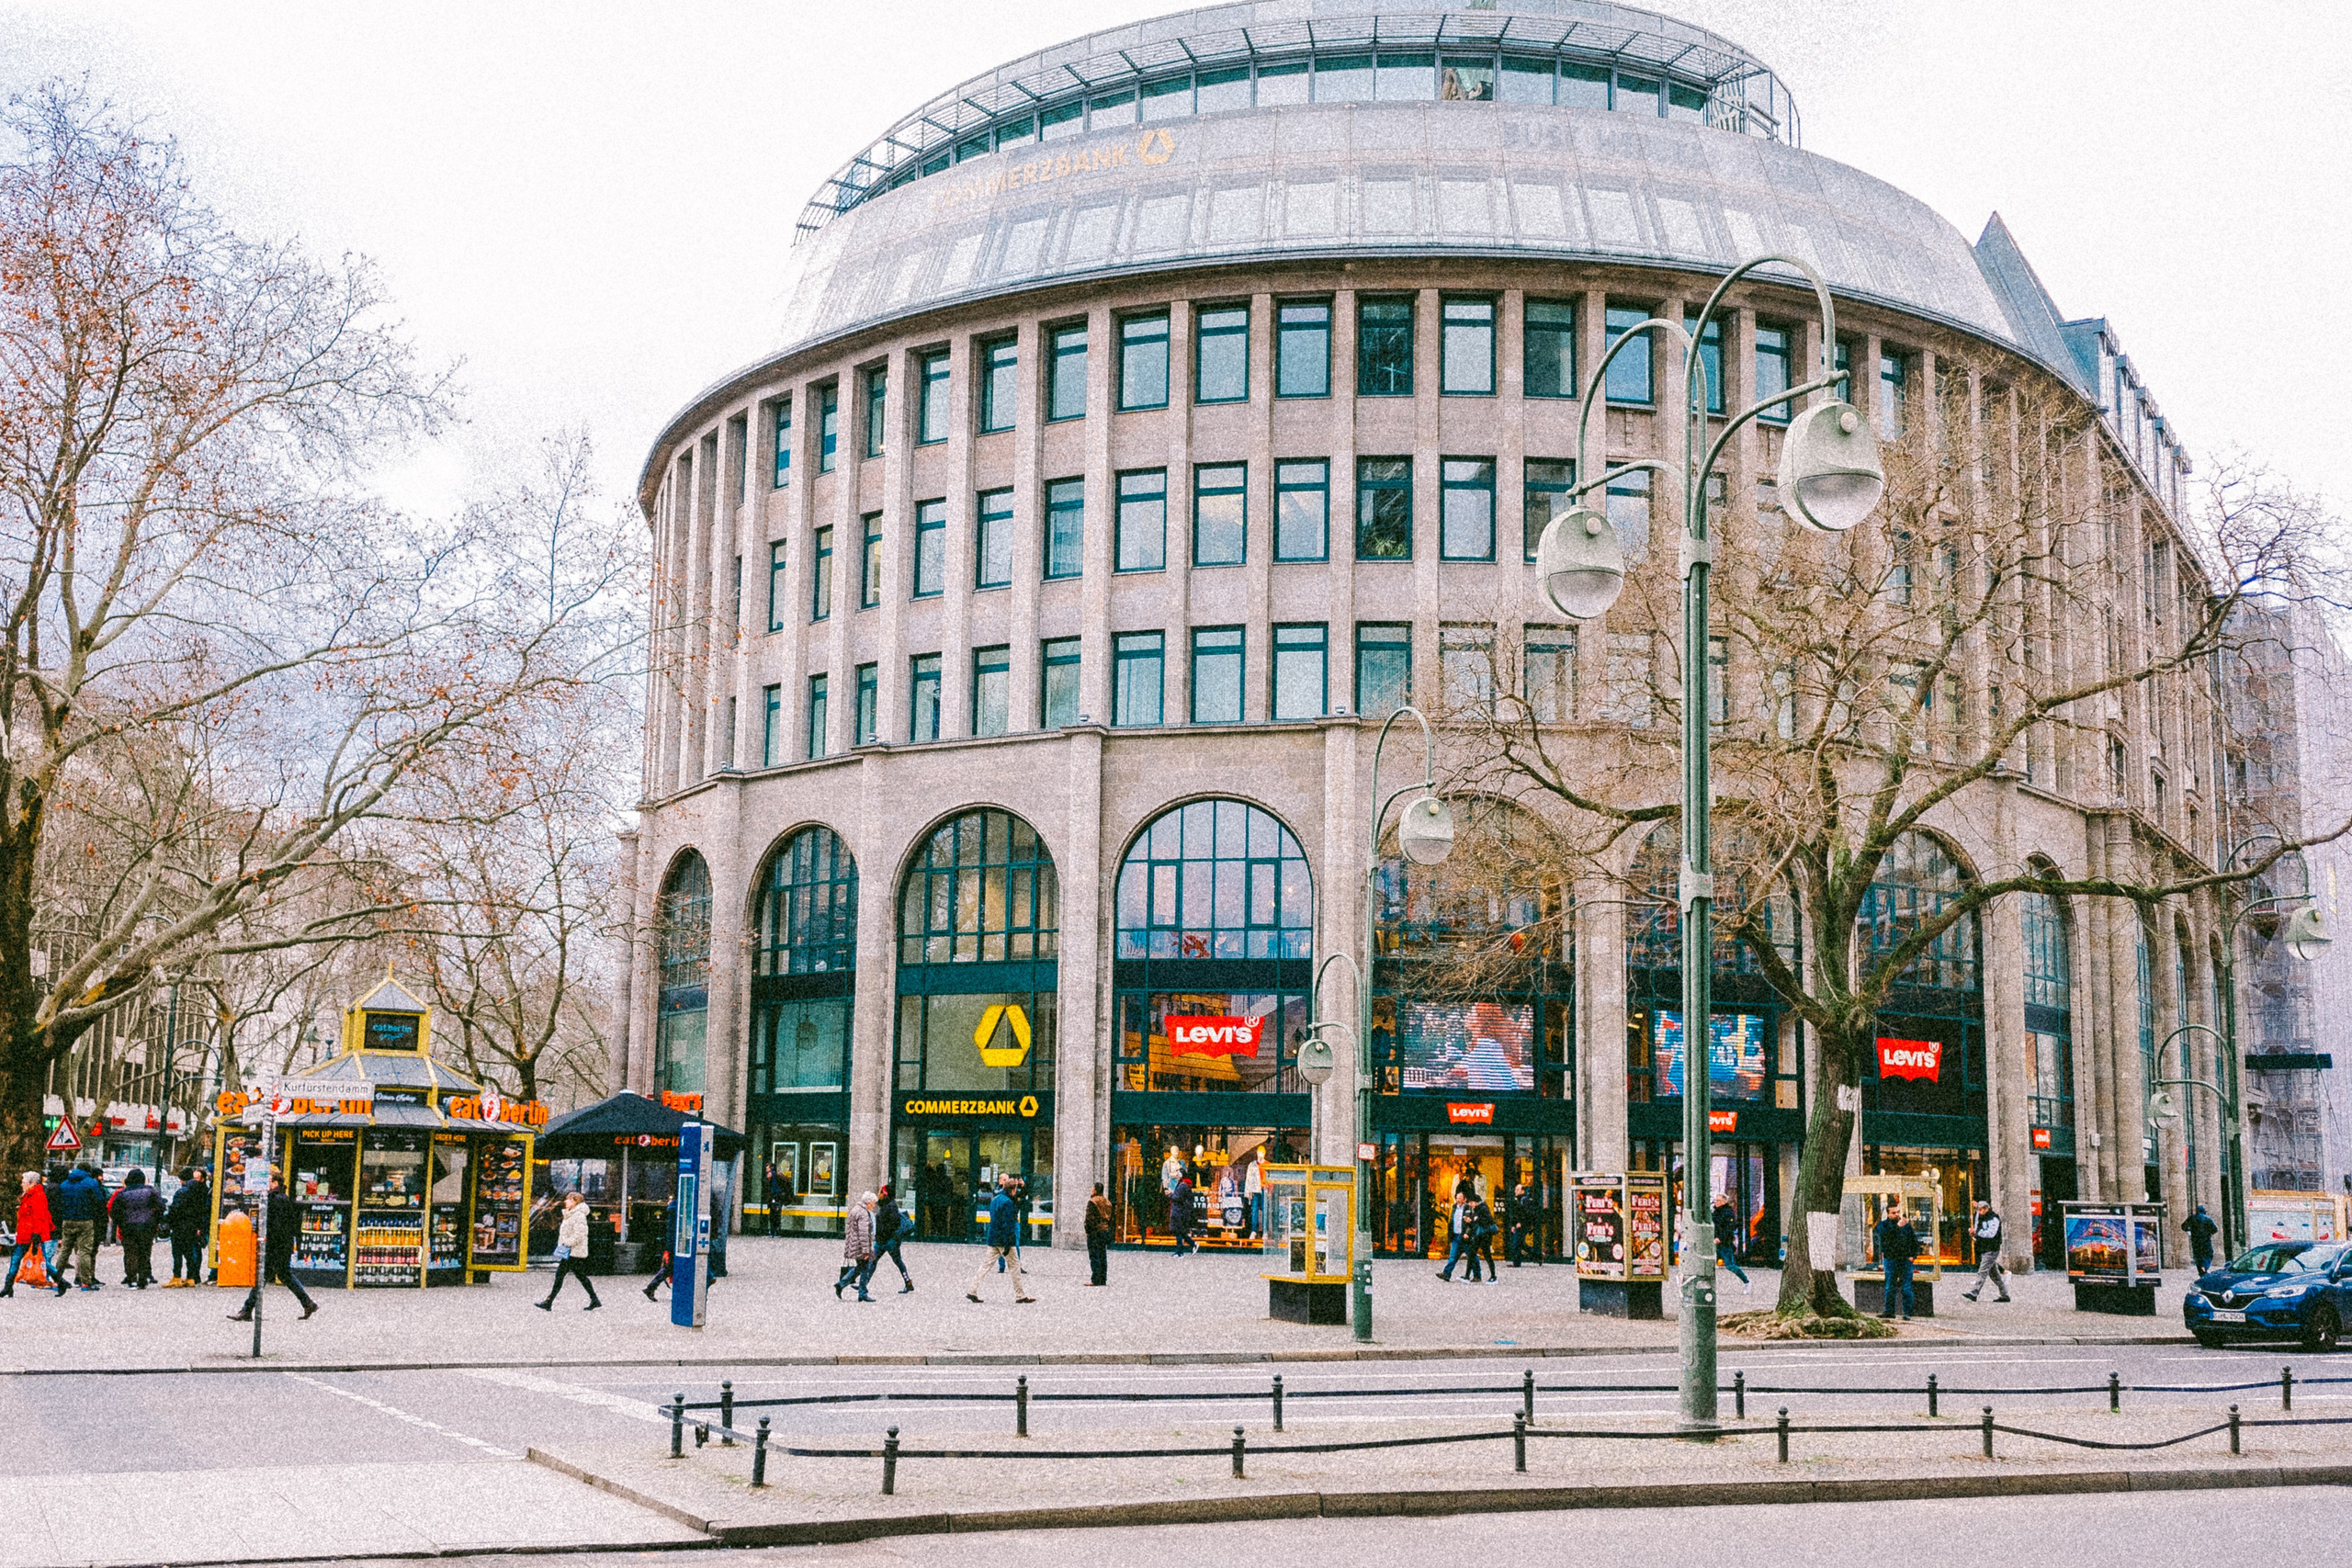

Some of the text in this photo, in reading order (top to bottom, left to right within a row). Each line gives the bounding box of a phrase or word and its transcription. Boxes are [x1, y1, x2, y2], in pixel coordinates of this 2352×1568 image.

[1176, 1026, 1252, 1043] Levi's
[1883, 1049, 1936, 1068] Levi's
[449, 1094, 481, 1121] eat
[500, 1098, 548, 1125] berlin
[905, 1100, 1016, 1114] COMMERZBANK
[1709, 1116, 1733, 1125] evi's
[302, 1130, 354, 1139] PICK UP HERE
[614, 1136, 680, 1146] eat berli
